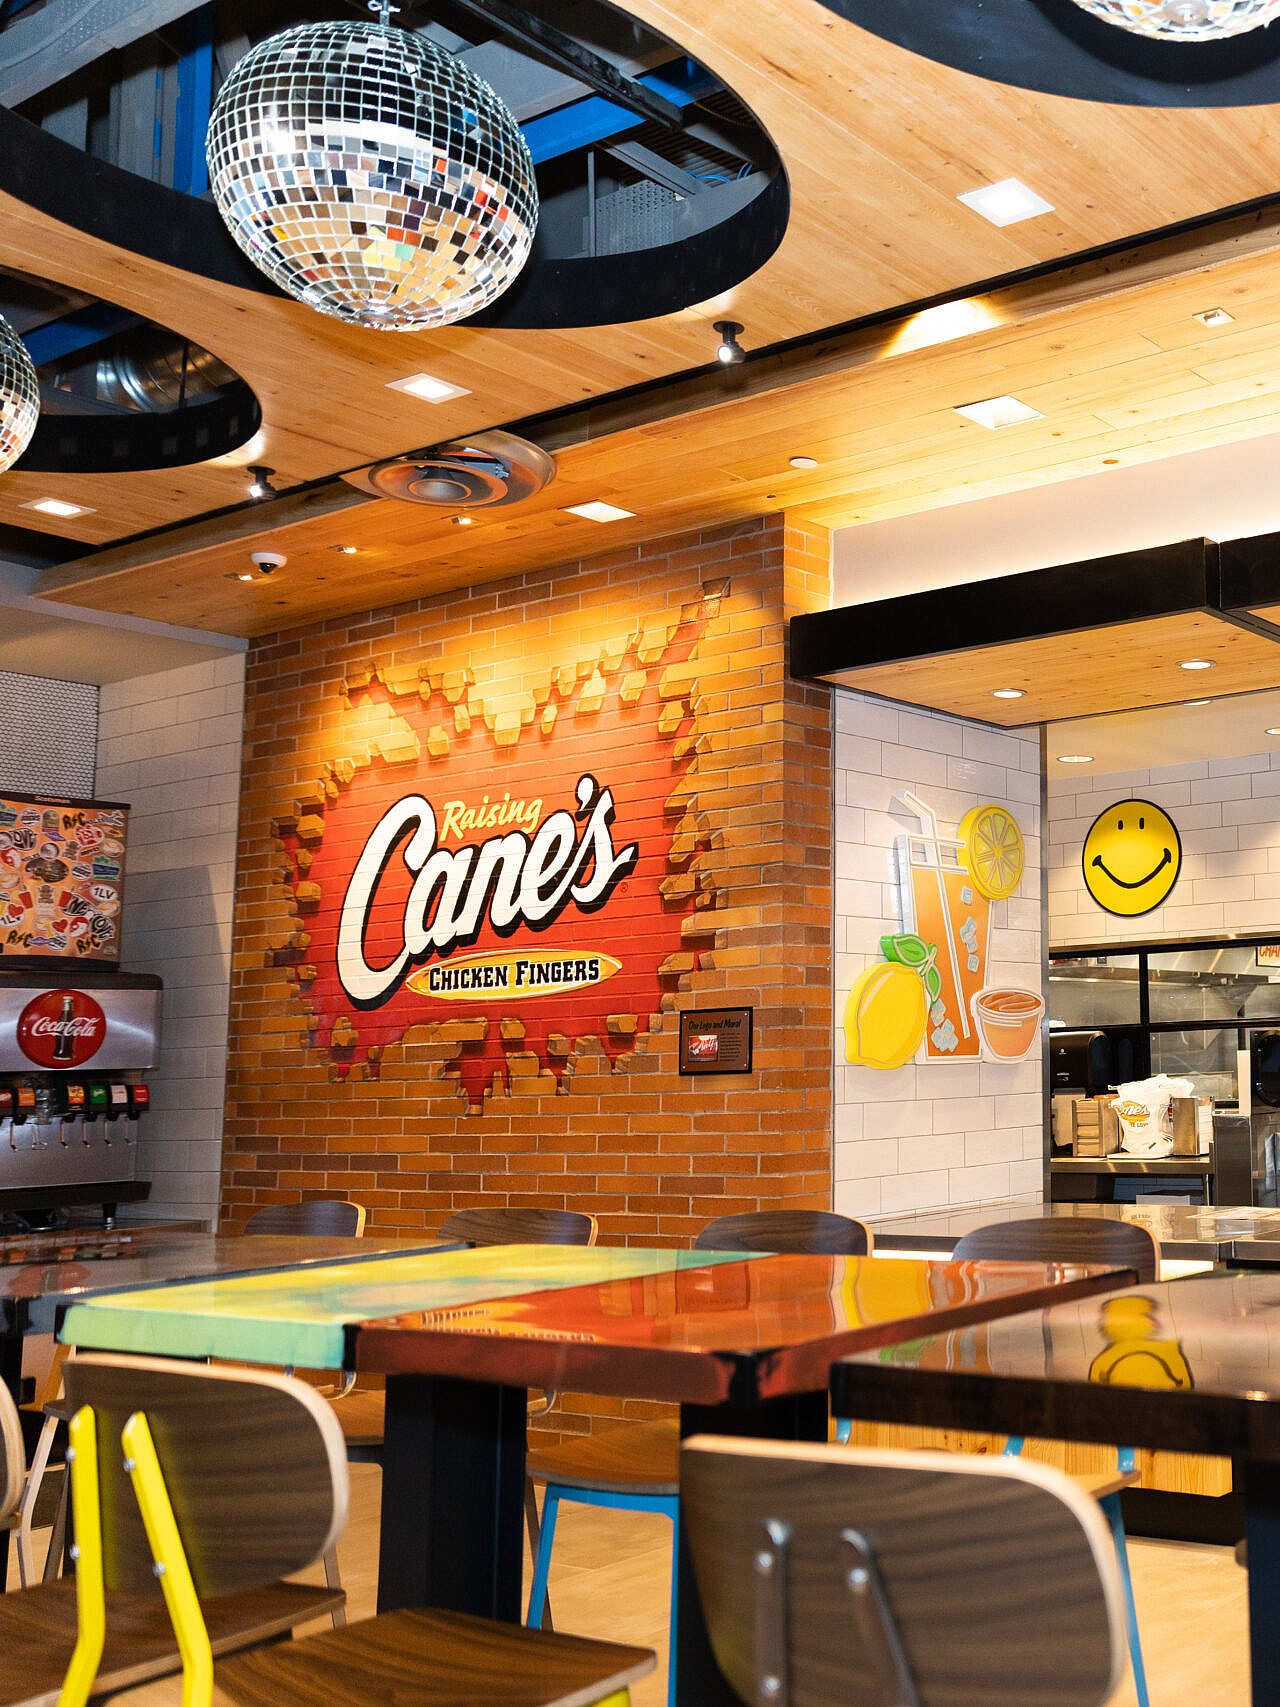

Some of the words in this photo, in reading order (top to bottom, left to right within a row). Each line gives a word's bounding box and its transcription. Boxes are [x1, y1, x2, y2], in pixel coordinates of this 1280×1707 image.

[440, 792, 543, 842] Raising
[336, 773, 639, 1008] Cane's
[429, 965, 508, 992] CHICKEN
[515, 957, 600, 986] FINGERS
